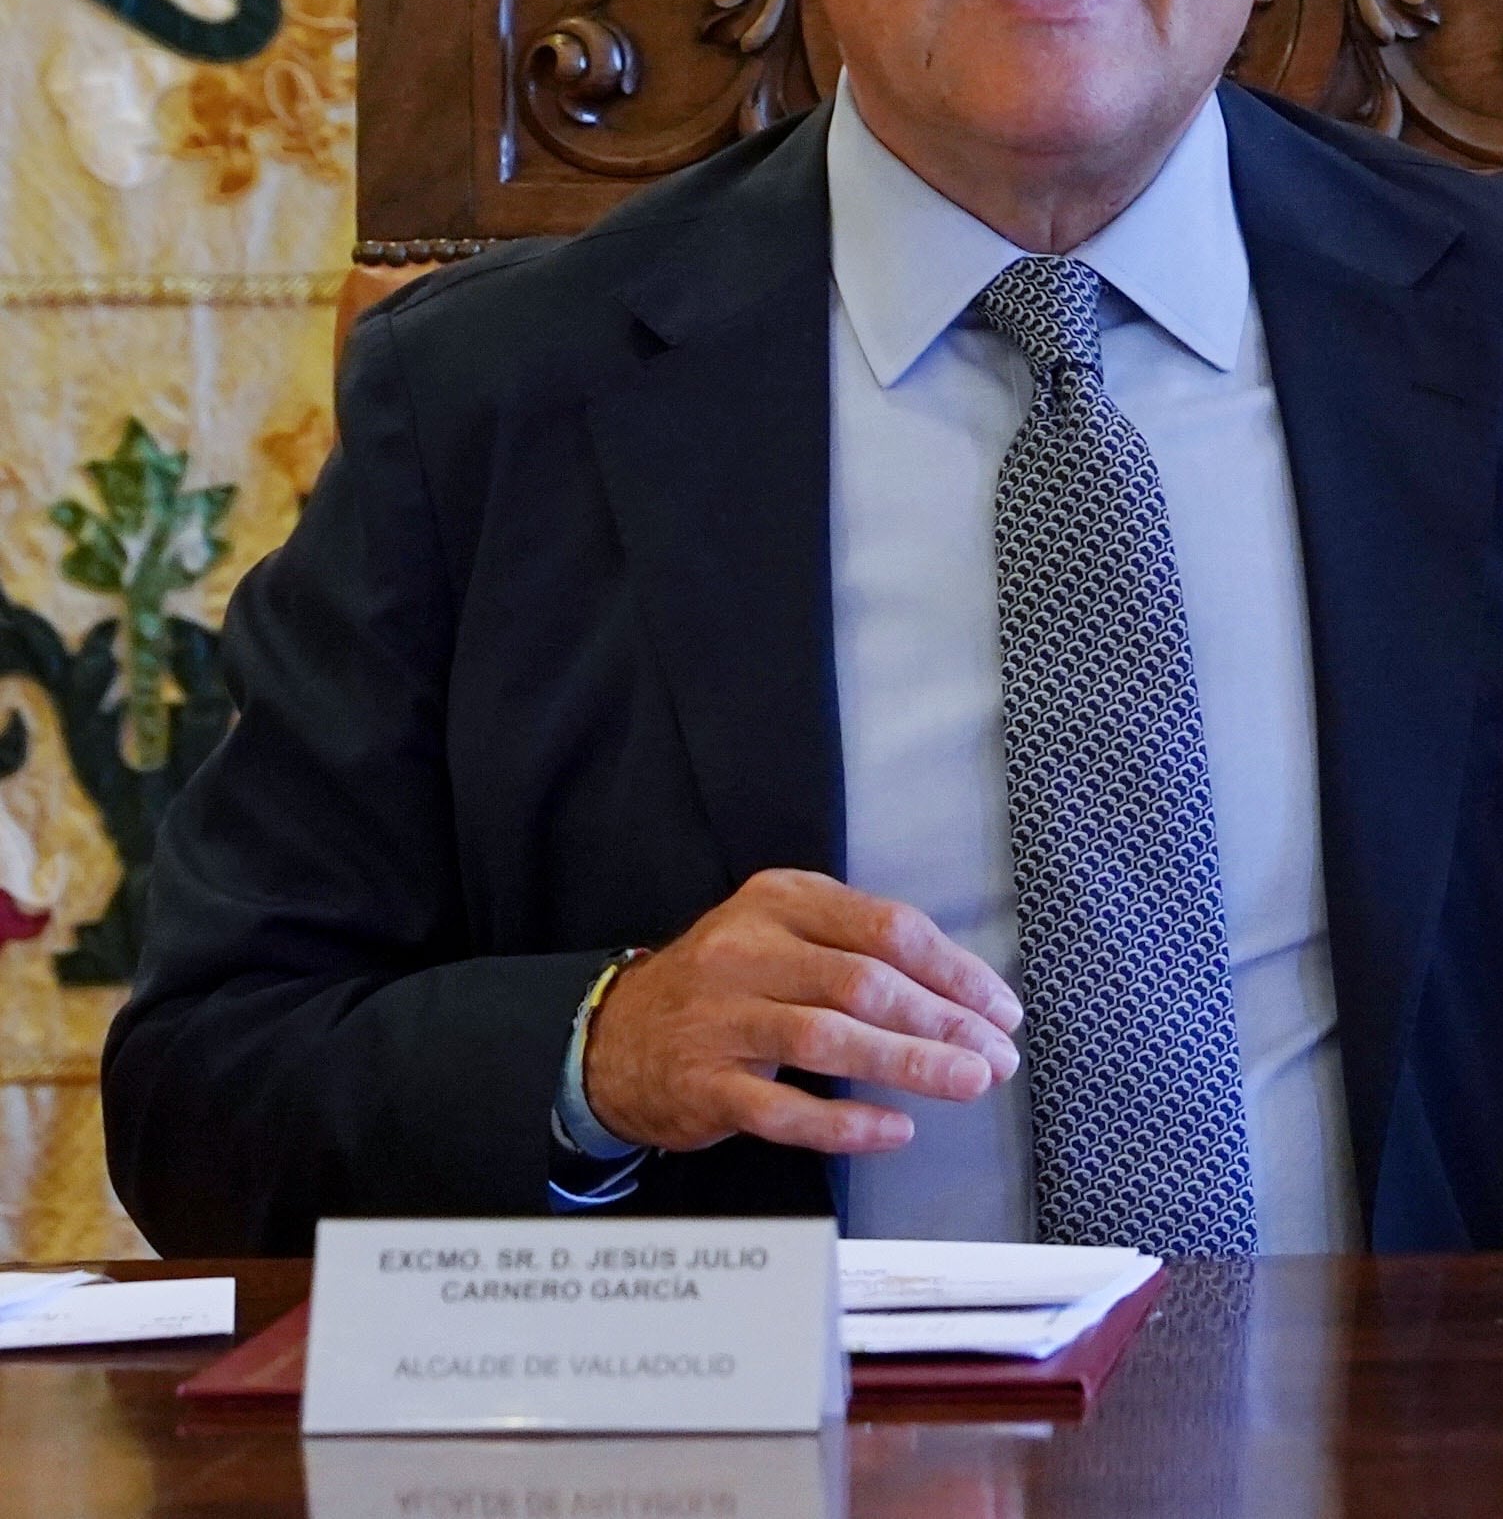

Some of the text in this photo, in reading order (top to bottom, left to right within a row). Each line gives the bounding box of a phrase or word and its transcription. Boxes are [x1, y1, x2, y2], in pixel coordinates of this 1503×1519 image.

[497, 1248, 538, 1271] SR.
[586, 1242, 676, 1270] JESÚS
[686, 1247, 770, 1270] JULIO
[441, 1273, 700, 1303] CARNERO GARCÍA
[394, 1353, 736, 1379] ALCALDE DE VALLADOLID
